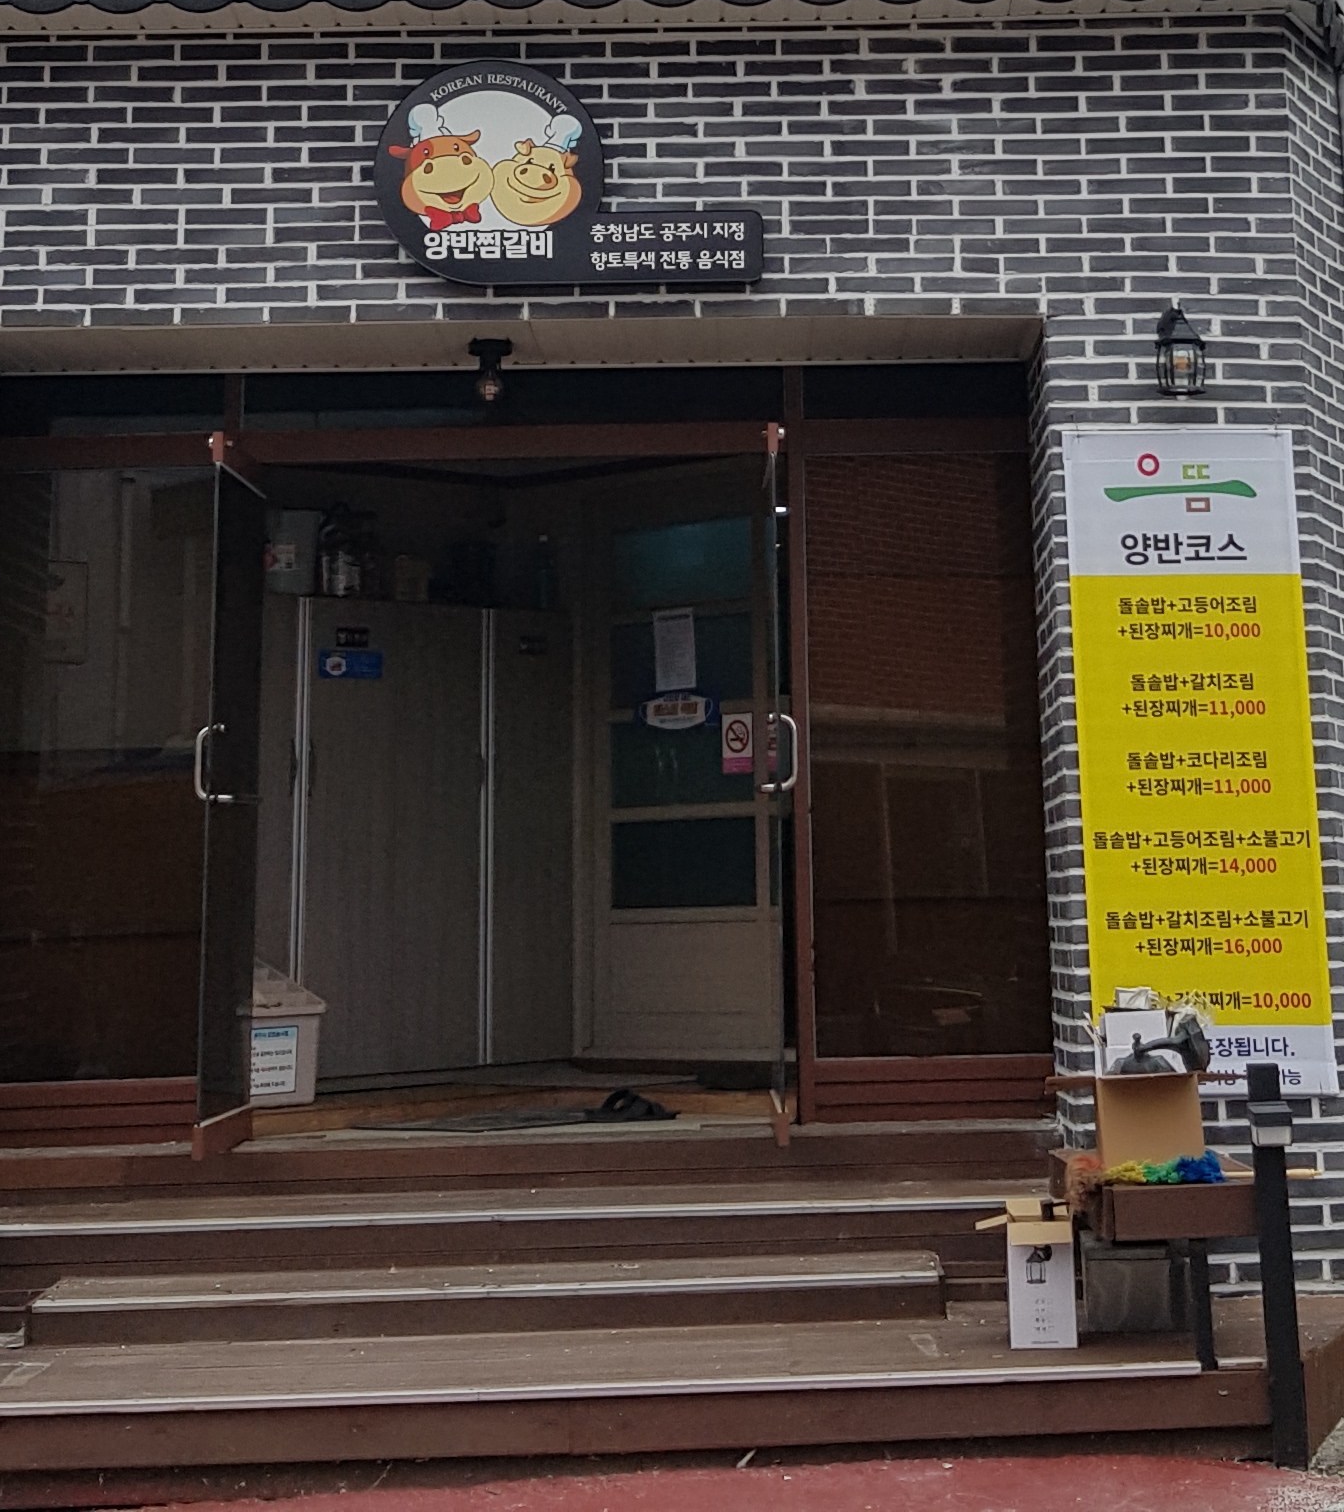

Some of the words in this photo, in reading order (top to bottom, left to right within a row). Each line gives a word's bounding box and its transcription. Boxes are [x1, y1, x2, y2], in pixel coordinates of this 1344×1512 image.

[430, 74, 483, 102] KOREAN
[487, 74, 567, 114] RESTAURANT
[424, 229, 553, 260] 양반찜갈비
[590, 223, 656, 243] 충청남도
[659, 222, 708, 242] 공주시
[713, 222, 745, 242] 지정
[590, 251, 656, 271] 향토특색
[659, 251, 693, 270] 전통
[697, 251, 745, 270] 음식점
[1120, 533, 1247, 565] 양반코스
